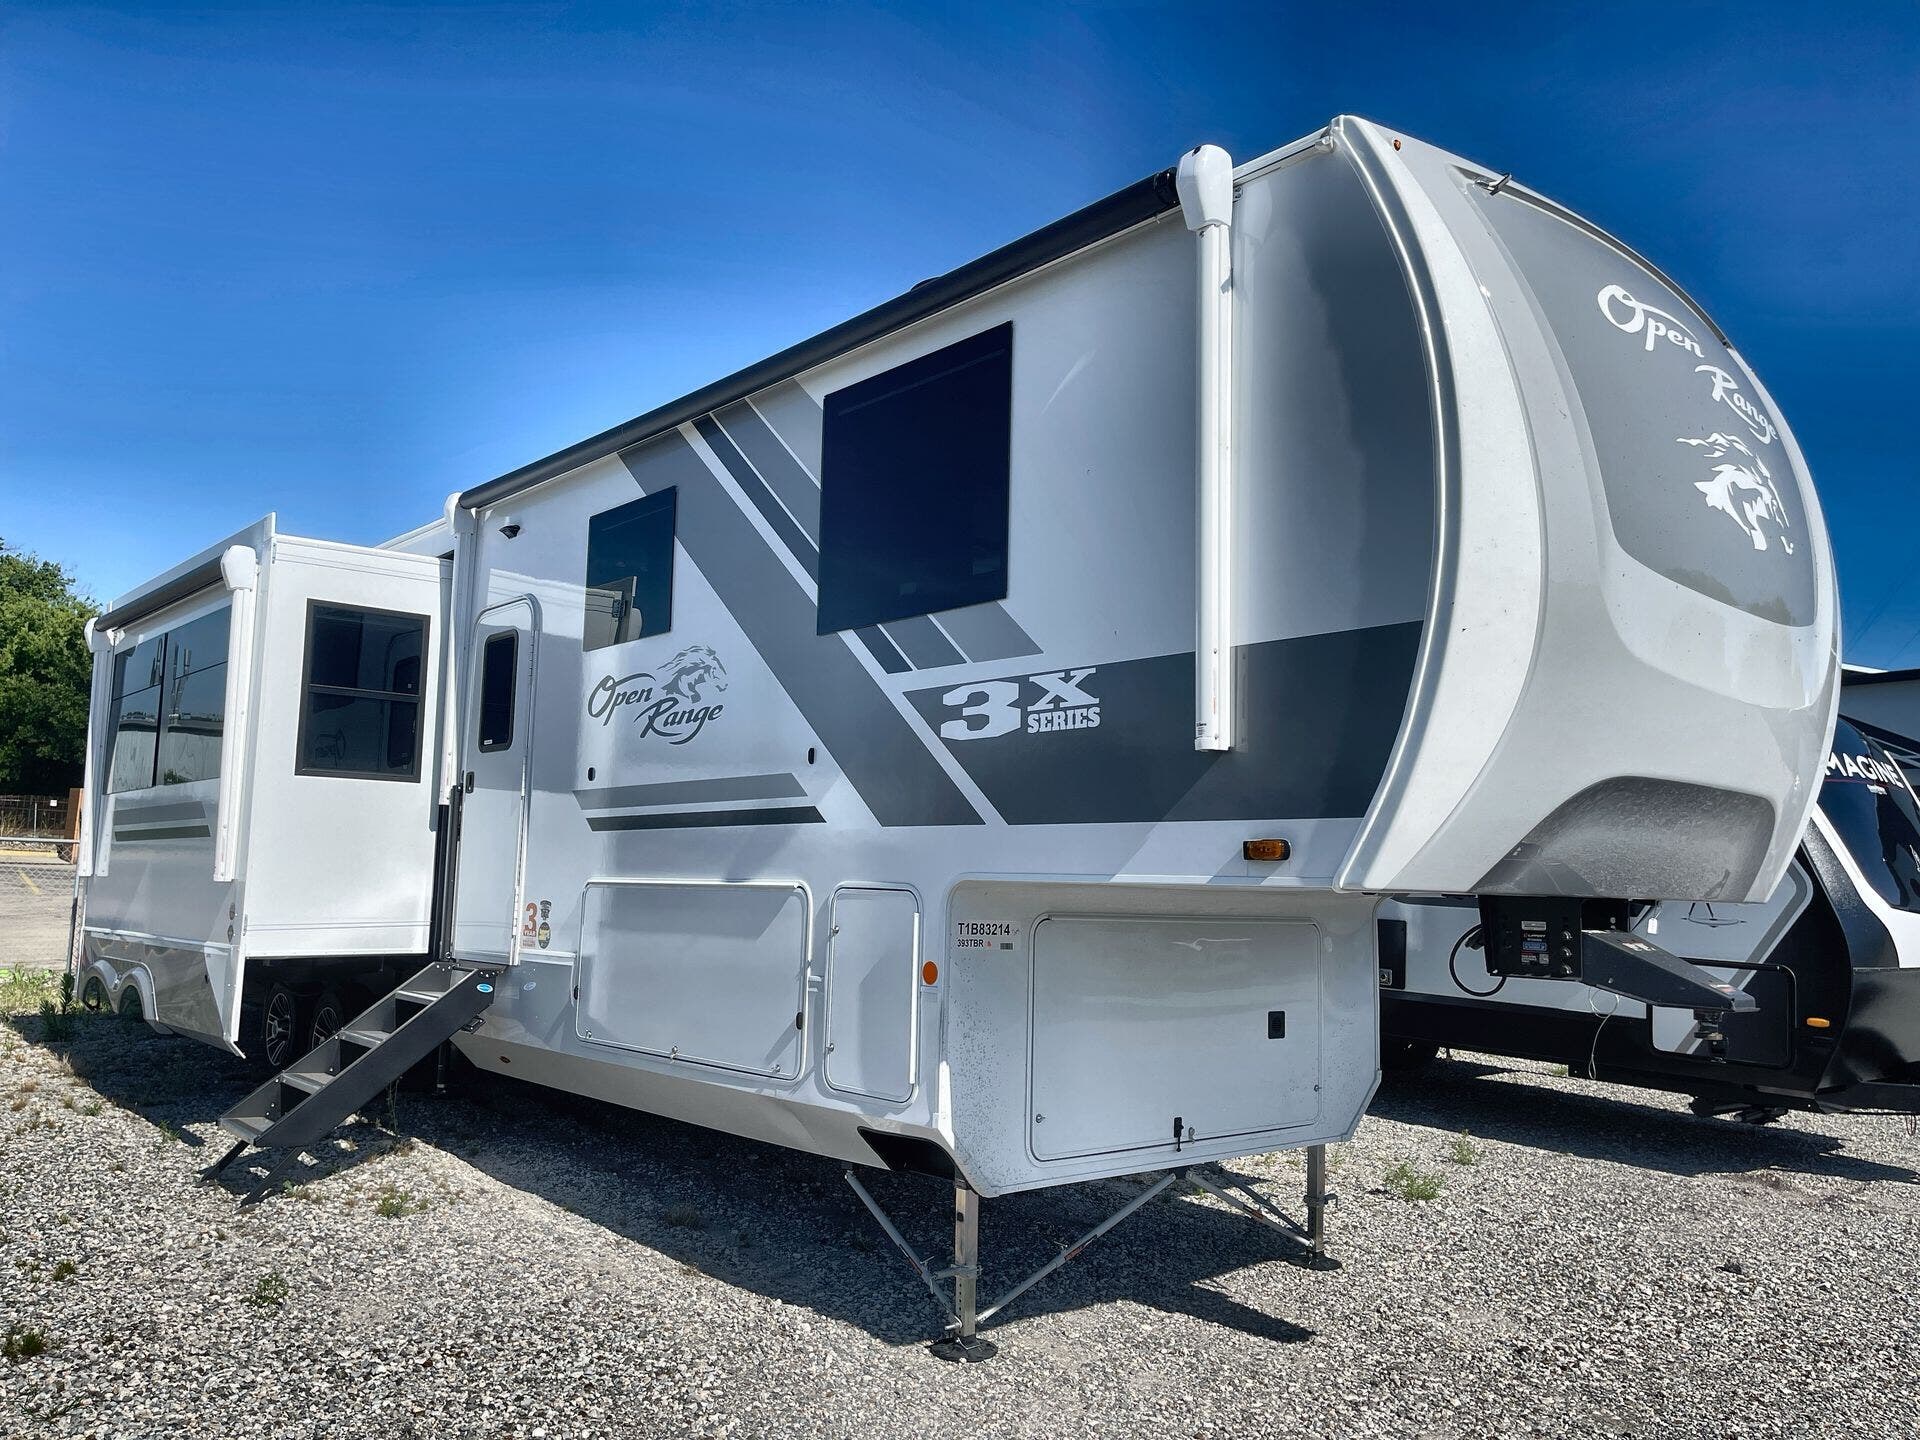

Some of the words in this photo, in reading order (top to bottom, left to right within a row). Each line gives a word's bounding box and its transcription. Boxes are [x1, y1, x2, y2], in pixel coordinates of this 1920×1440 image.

[1597, 284, 1704, 358] Open
[1694, 364, 1779, 445] Range
[587, 672, 657, 726] Open
[633, 696, 724, 745] Range
[1027, 706, 1101, 734] SERIES
[1825, 750, 1905, 789] MAGINE
[525, 902, 538, 931] 3
[957, 922, 1011, 936] T1B83214
[957, 938, 984, 948] 393TBR
